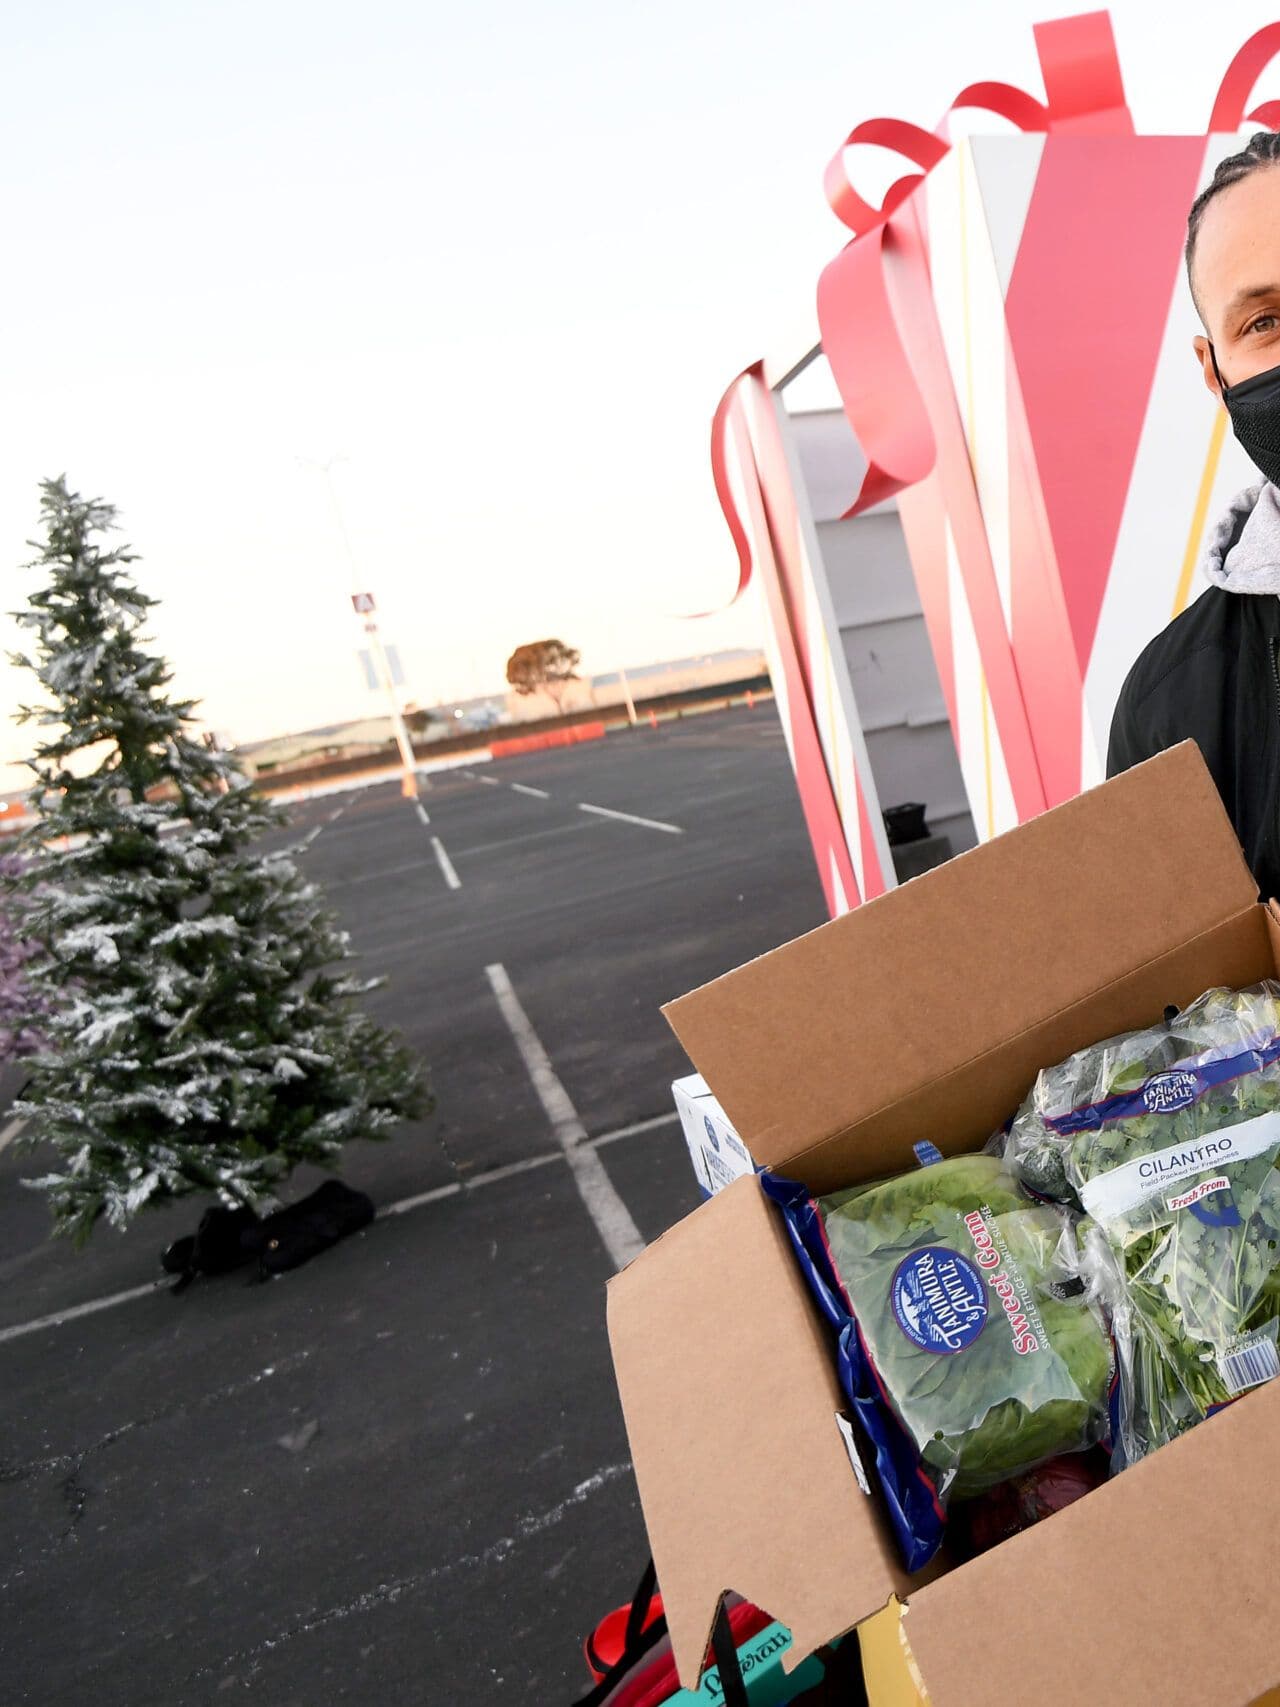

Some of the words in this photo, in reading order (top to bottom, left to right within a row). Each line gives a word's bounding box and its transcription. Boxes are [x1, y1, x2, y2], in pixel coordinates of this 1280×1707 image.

[1149, 1086, 1193, 1113] ANTLE
[1139, 1138, 1232, 1178] CILANTRO
[1140, 1168, 1188, 1190] Field-Packed
[1190, 1164, 1200, 1173] for
[1202, 1150, 1239, 1167] Freshness
[1171, 1190, 1198, 1209] Fresh
[1200, 1179, 1226, 1196] From
[964, 1210, 1000, 1270] Gem
[915, 1253, 972, 1348] TANIMURA
[938, 1259, 988, 1315] ANTLE
[1013, 1273, 1035, 1315] LETTUCE
[966, 1311, 980, 1322] &
[988, 1270, 1039, 1354] Sweet
[1031, 1315, 1050, 1349] SWEET
[704, 1631, 792, 1700] Lerati
